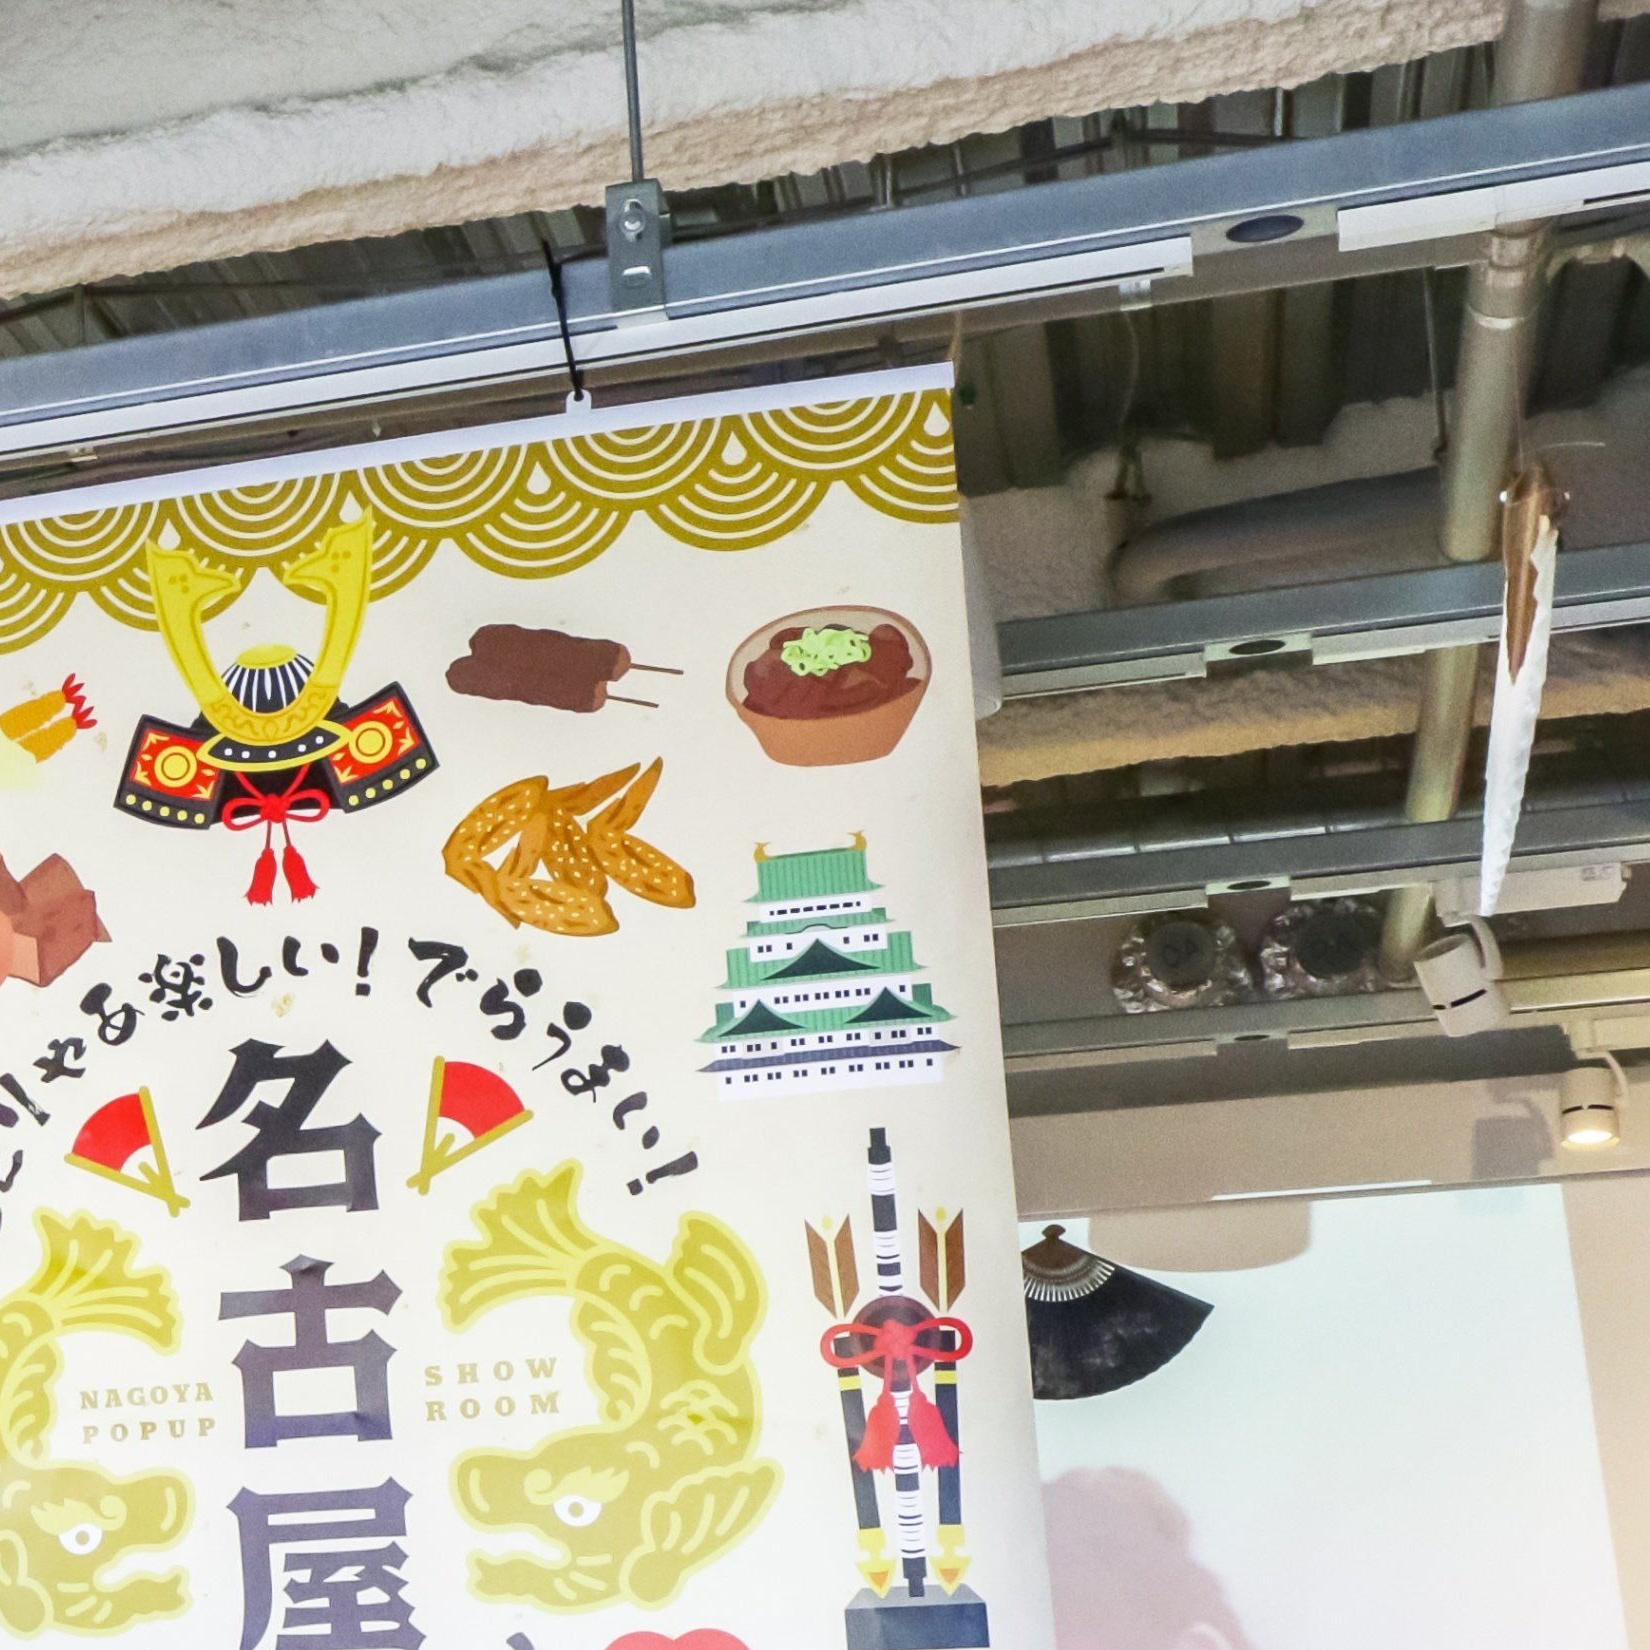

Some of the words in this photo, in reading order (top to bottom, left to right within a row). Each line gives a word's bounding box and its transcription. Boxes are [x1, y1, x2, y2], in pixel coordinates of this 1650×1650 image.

[424, 1356, 558, 1387] SHOW
[79, 1381, 215, 1411] NAGOYA
[425, 1390, 560, 1422] ROOM
[81, 1417, 217, 1445] POPUP
